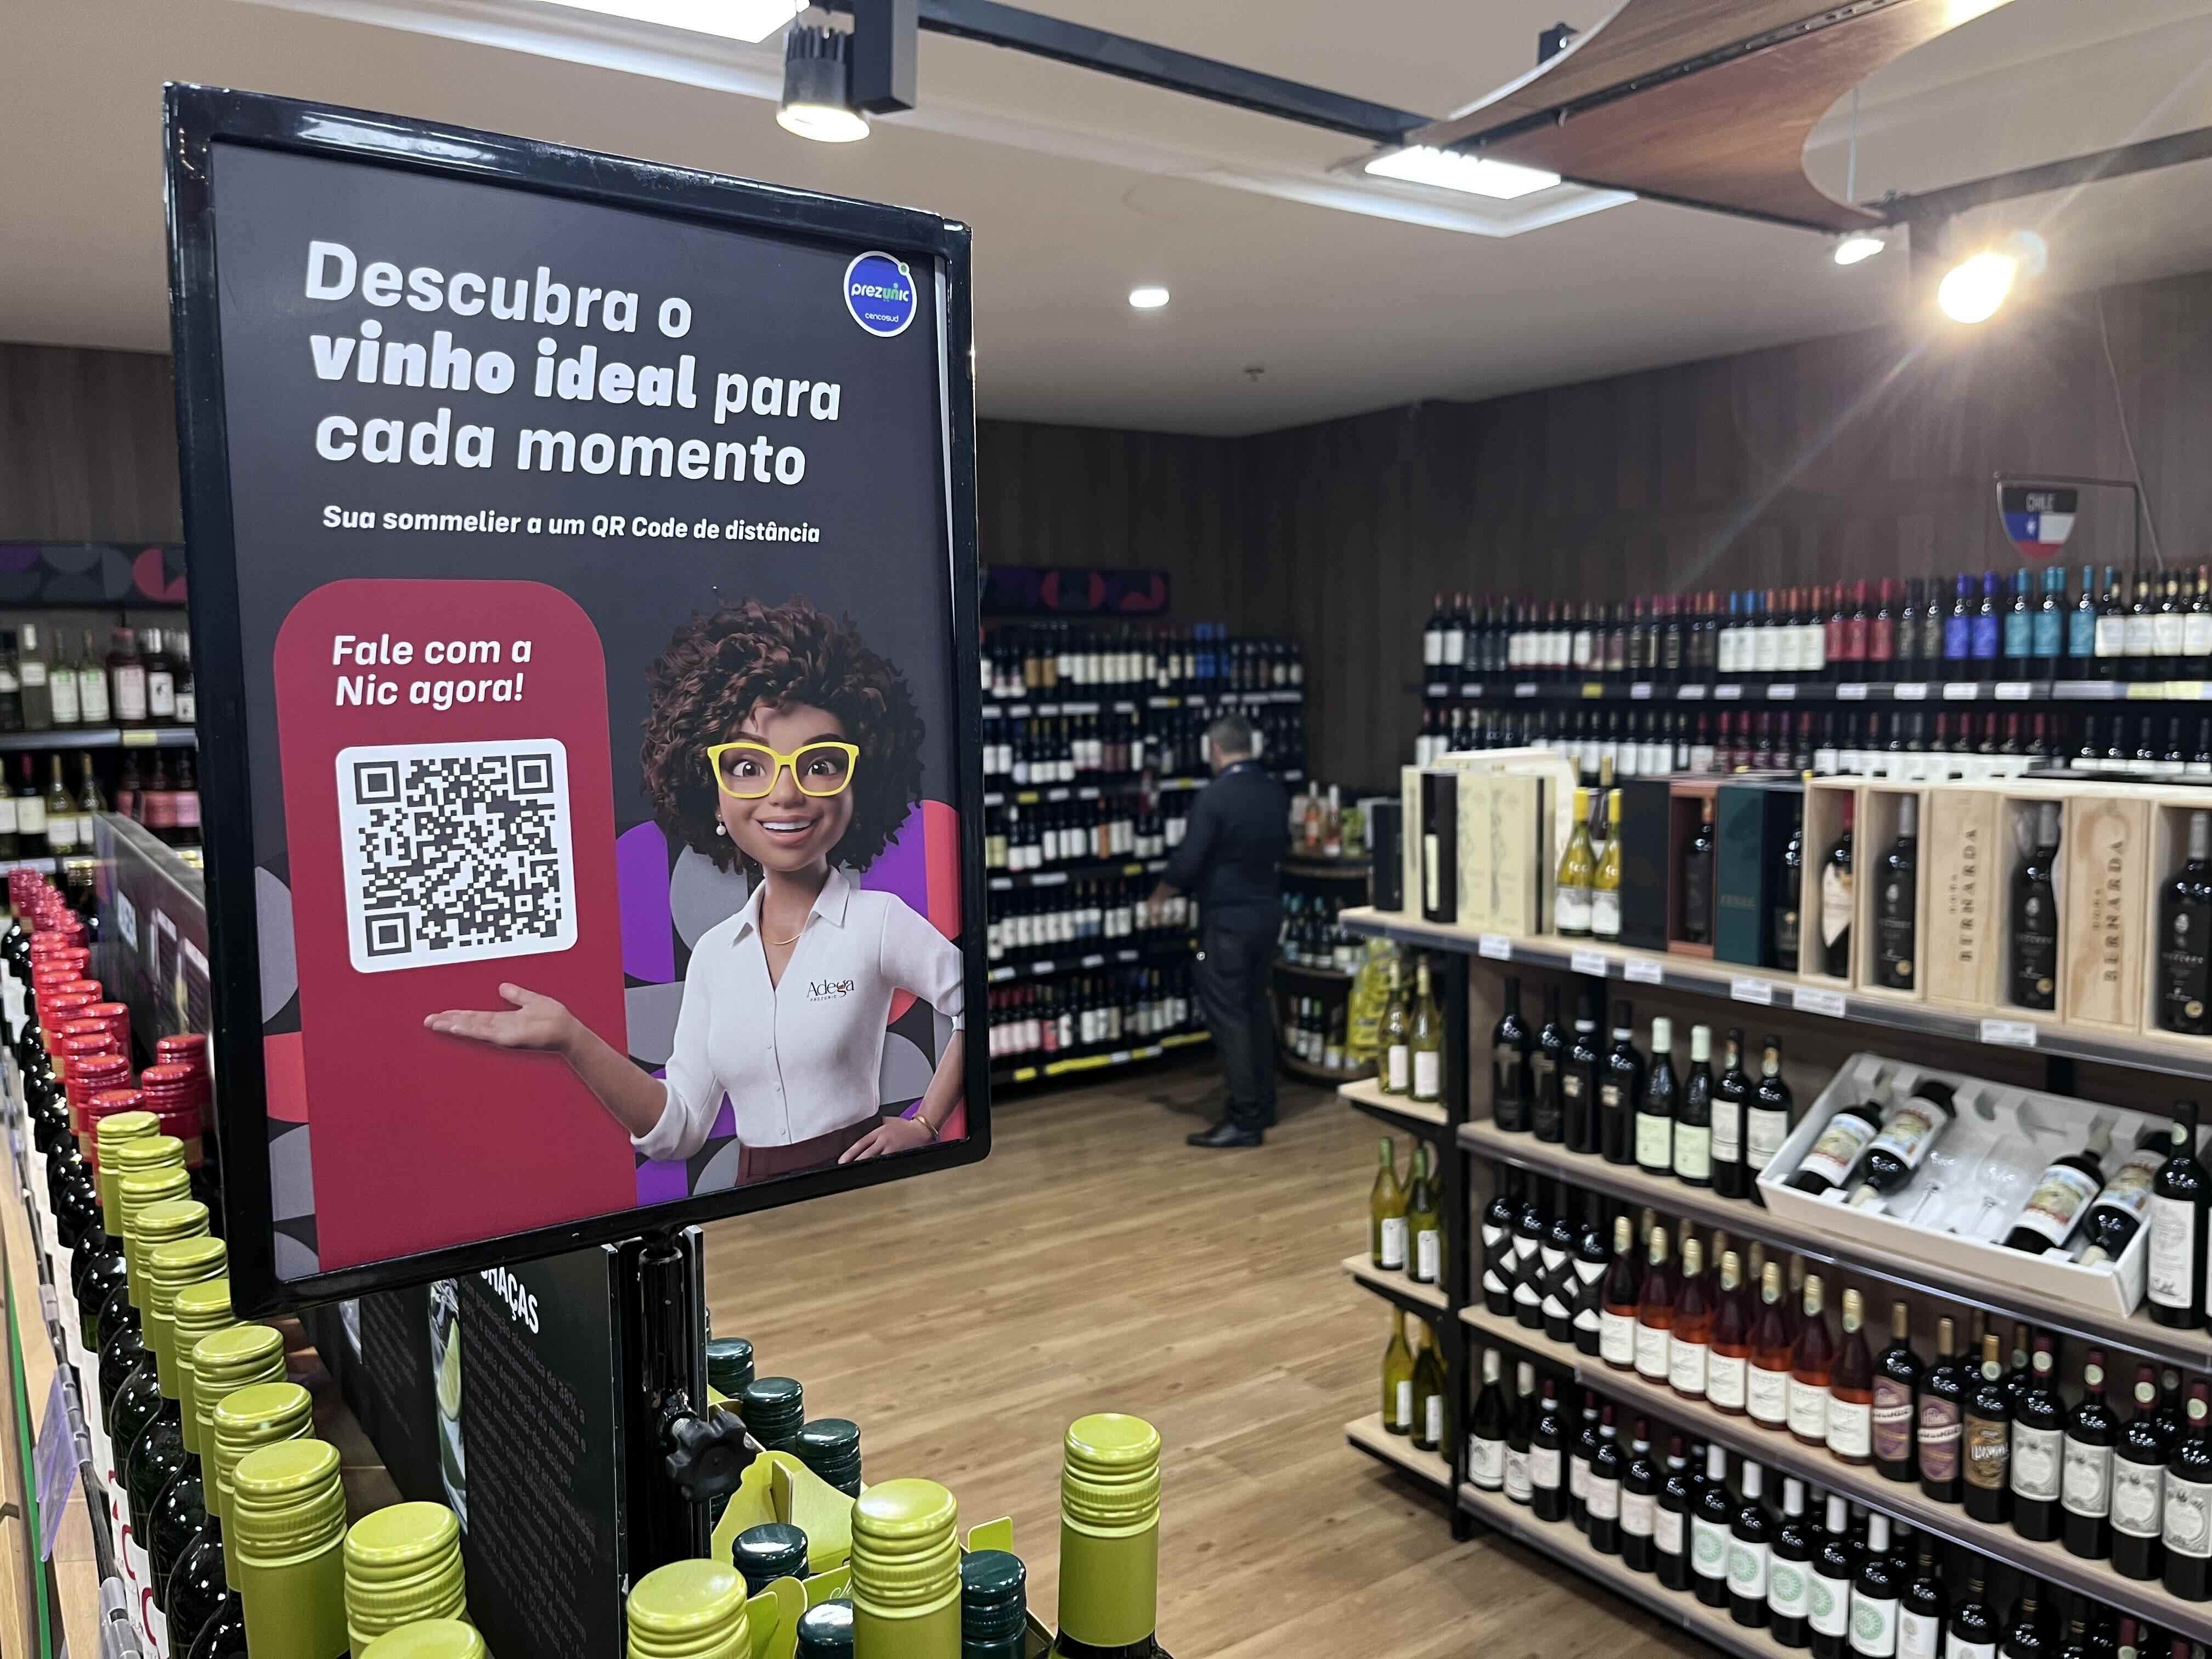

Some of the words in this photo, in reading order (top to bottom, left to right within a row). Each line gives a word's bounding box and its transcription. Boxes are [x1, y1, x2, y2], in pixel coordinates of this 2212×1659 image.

[306, 241, 638, 333] Descubra
[659, 298, 691, 337] o
[851, 283, 910, 302] prezunic
[865, 313, 899, 323] cencosud
[310, 319, 515, 393] vinho
[535, 337, 696, 408] ideal
[714, 374, 840, 424] para
[316, 408, 494, 467] cada
[518, 430, 805, 484] momento
[323, 506, 375, 528] Sua
[383, 510, 521, 532] sommelier
[527, 518, 541, 533] a
[549, 518, 584, 534] um
[592, 515, 625, 537] QR
[632, 517, 687, 538] Code
[694, 519, 719, 539] de
[726, 520, 819, 542] distância
[333, 634, 413, 665] Fale
[425, 641, 500, 664] com
[512, 641, 531, 662] a
[336, 674, 398, 706] Nic
[410, 673, 523, 710] agora!
[806, 979, 854, 997] Adega
